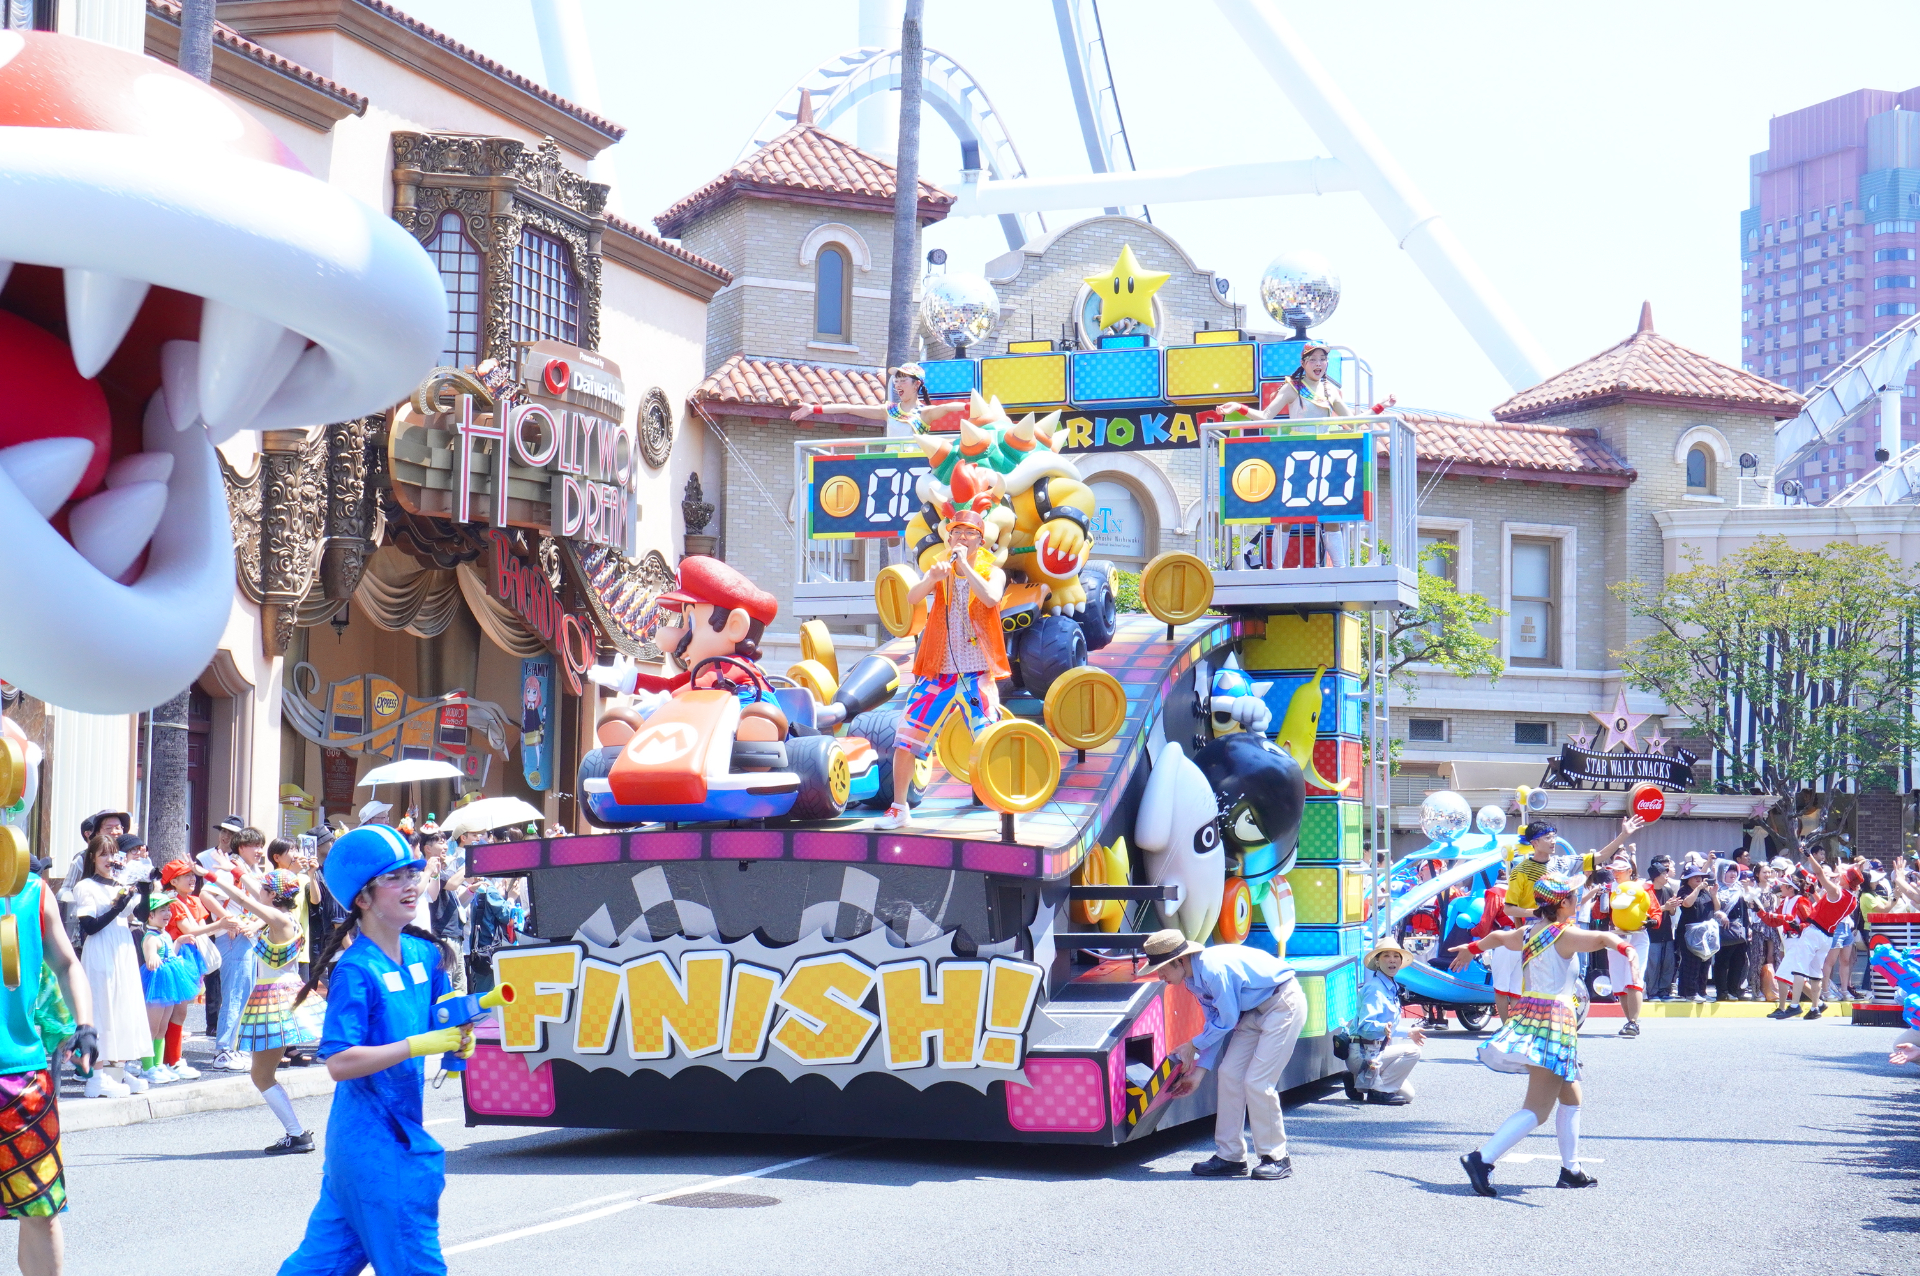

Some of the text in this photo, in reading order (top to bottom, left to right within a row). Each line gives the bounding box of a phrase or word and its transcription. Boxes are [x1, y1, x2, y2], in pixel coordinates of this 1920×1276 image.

[579, 352, 605, 370] Presented by
[1055, 416, 1135, 449] RIO
[1281, 449, 1358, 507] 00
[562, 474, 629, 551] DREAM
[1090, 507, 1123, 533] STN
[489, 529, 596, 697] BACKDROP
[376, 695, 398, 713] EXPRESS
[632, 728, 689, 754] M
[1584, 756, 1672, 780] STAR WALK SNACKS
[493, 944, 1045, 1070] FINISH!
